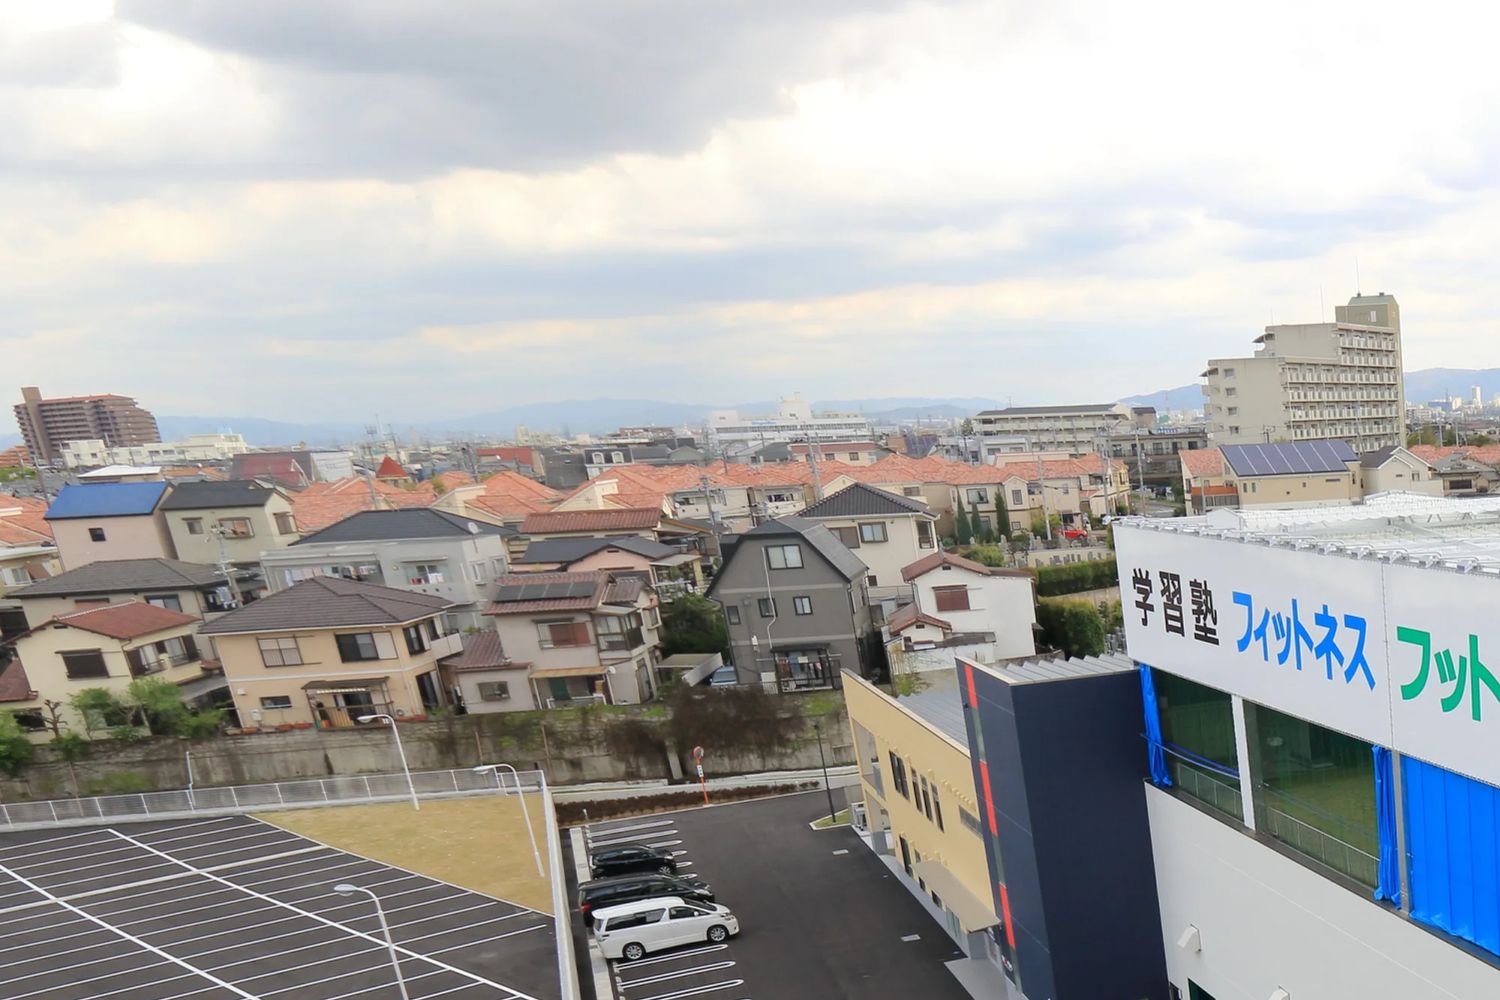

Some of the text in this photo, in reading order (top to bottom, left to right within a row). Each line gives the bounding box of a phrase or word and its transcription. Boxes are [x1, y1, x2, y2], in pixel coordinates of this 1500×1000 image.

[1132, 567, 1220, 646] 学習塾
[1231, 591, 1376, 690] フィットネス
